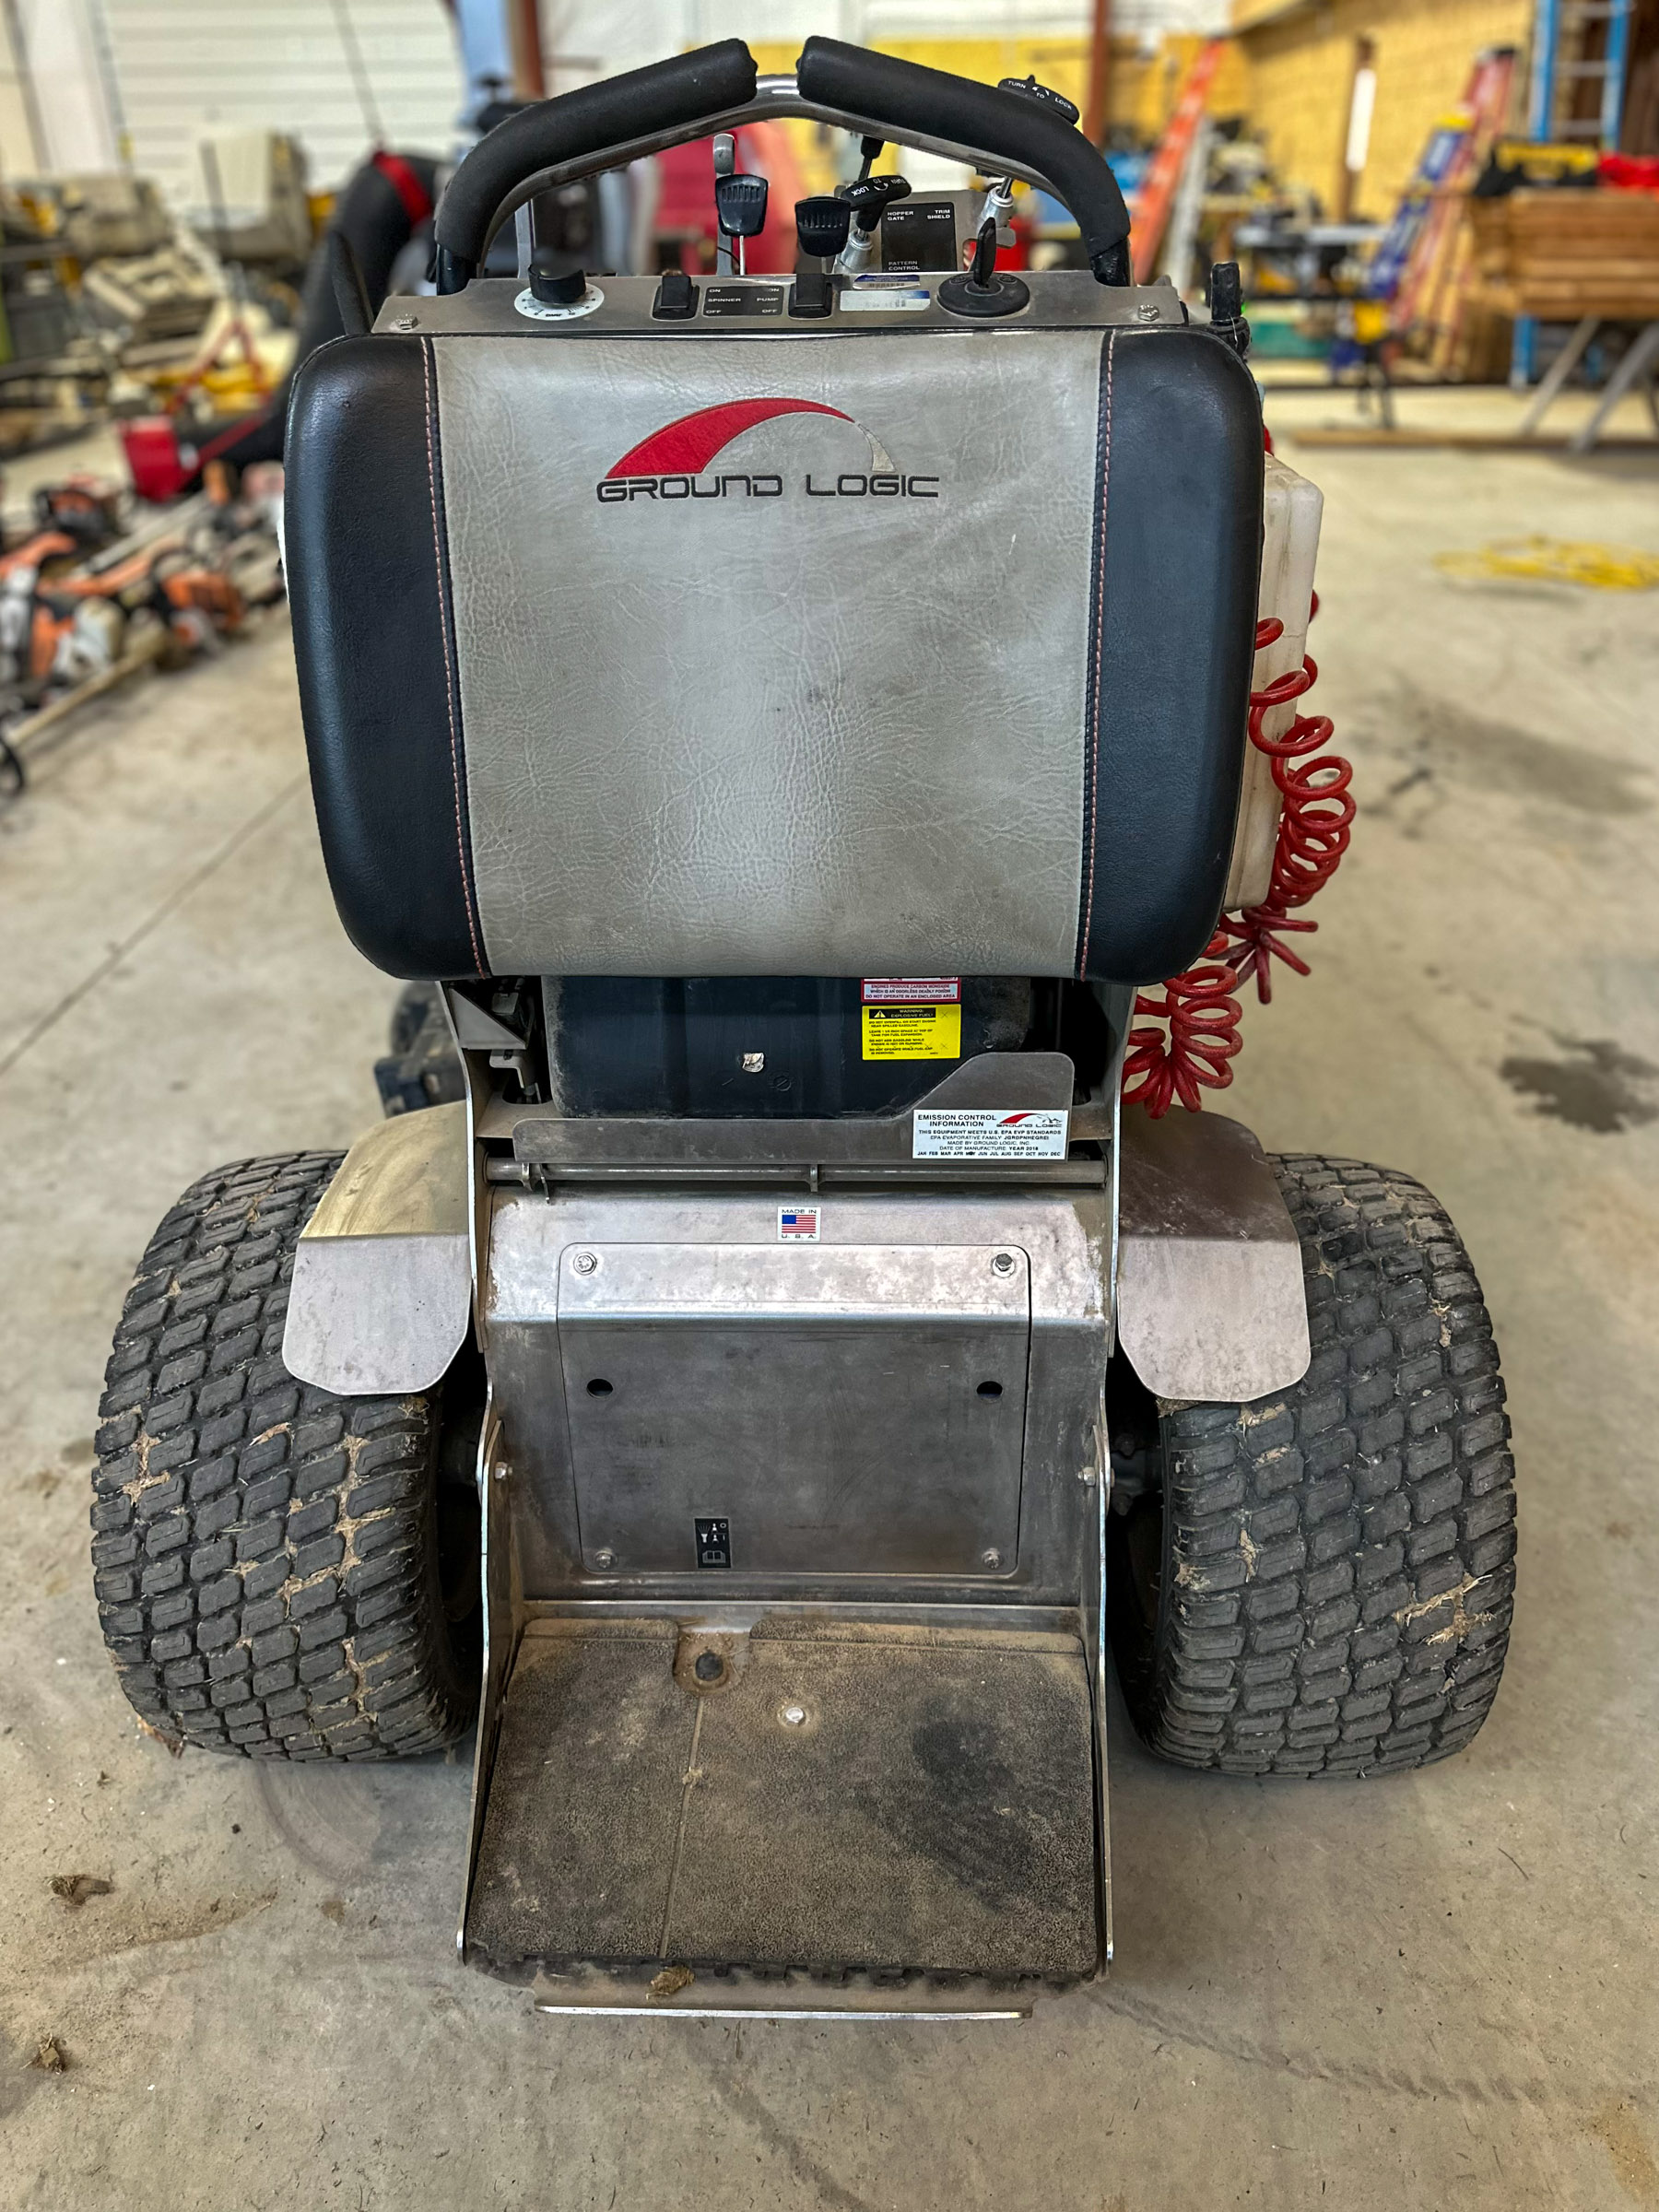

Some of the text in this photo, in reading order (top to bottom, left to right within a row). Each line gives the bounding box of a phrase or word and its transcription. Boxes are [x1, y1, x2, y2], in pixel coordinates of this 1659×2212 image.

[1007, 80, 1027, 89] TURN
[1054, 97, 1072, 111] LOCK
[851, 185, 870, 197] LOCK
[595, 474, 940, 503] GROUND LOGIC
